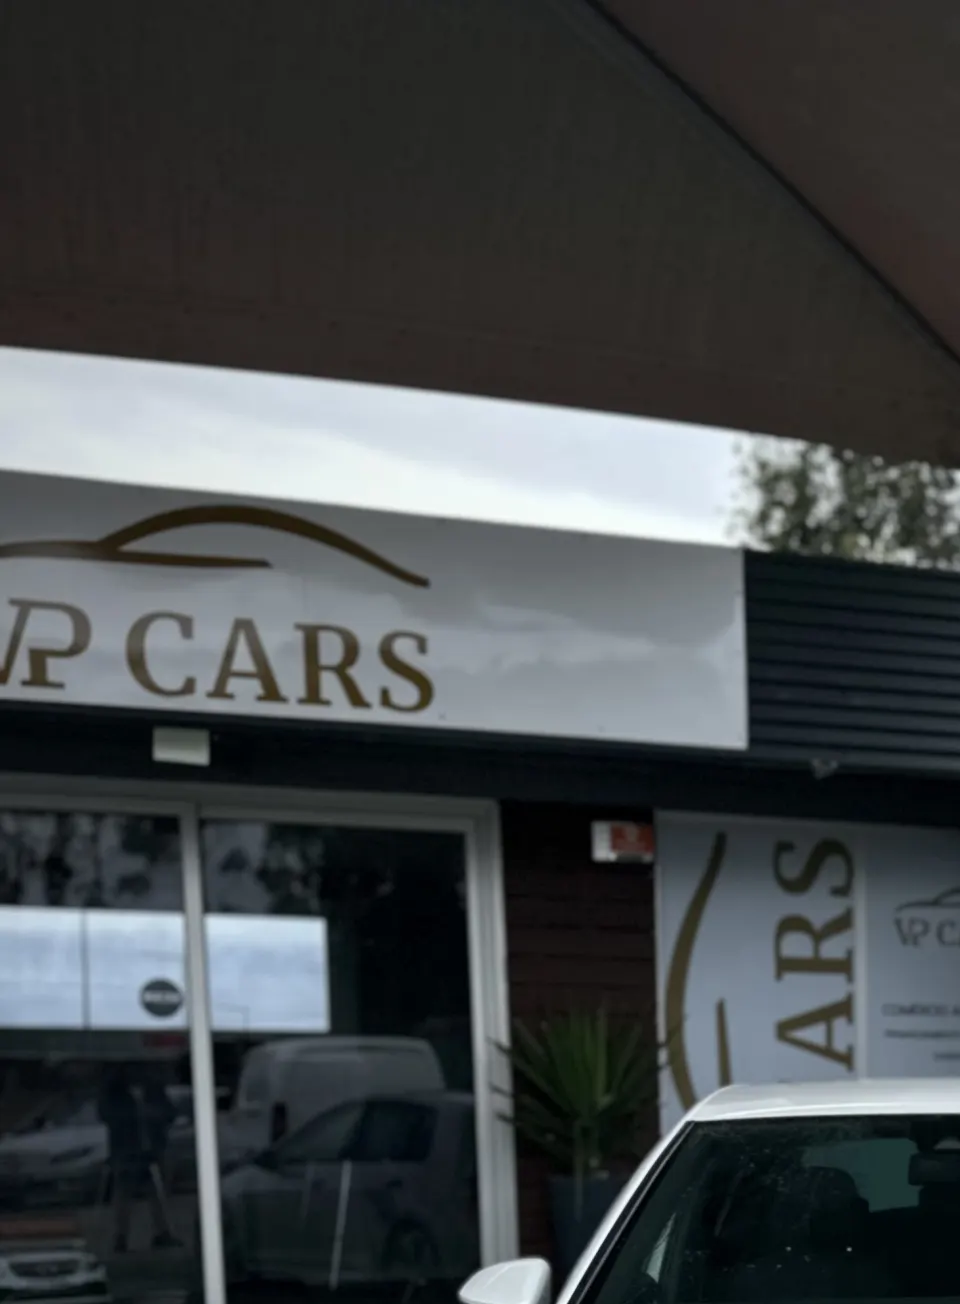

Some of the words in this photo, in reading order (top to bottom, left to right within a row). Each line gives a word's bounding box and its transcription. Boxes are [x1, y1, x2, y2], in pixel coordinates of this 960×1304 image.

[125, 610, 435, 713] CARS
[772, 837, 854, 1083] ARS
[894, 917, 931, 949] VP
